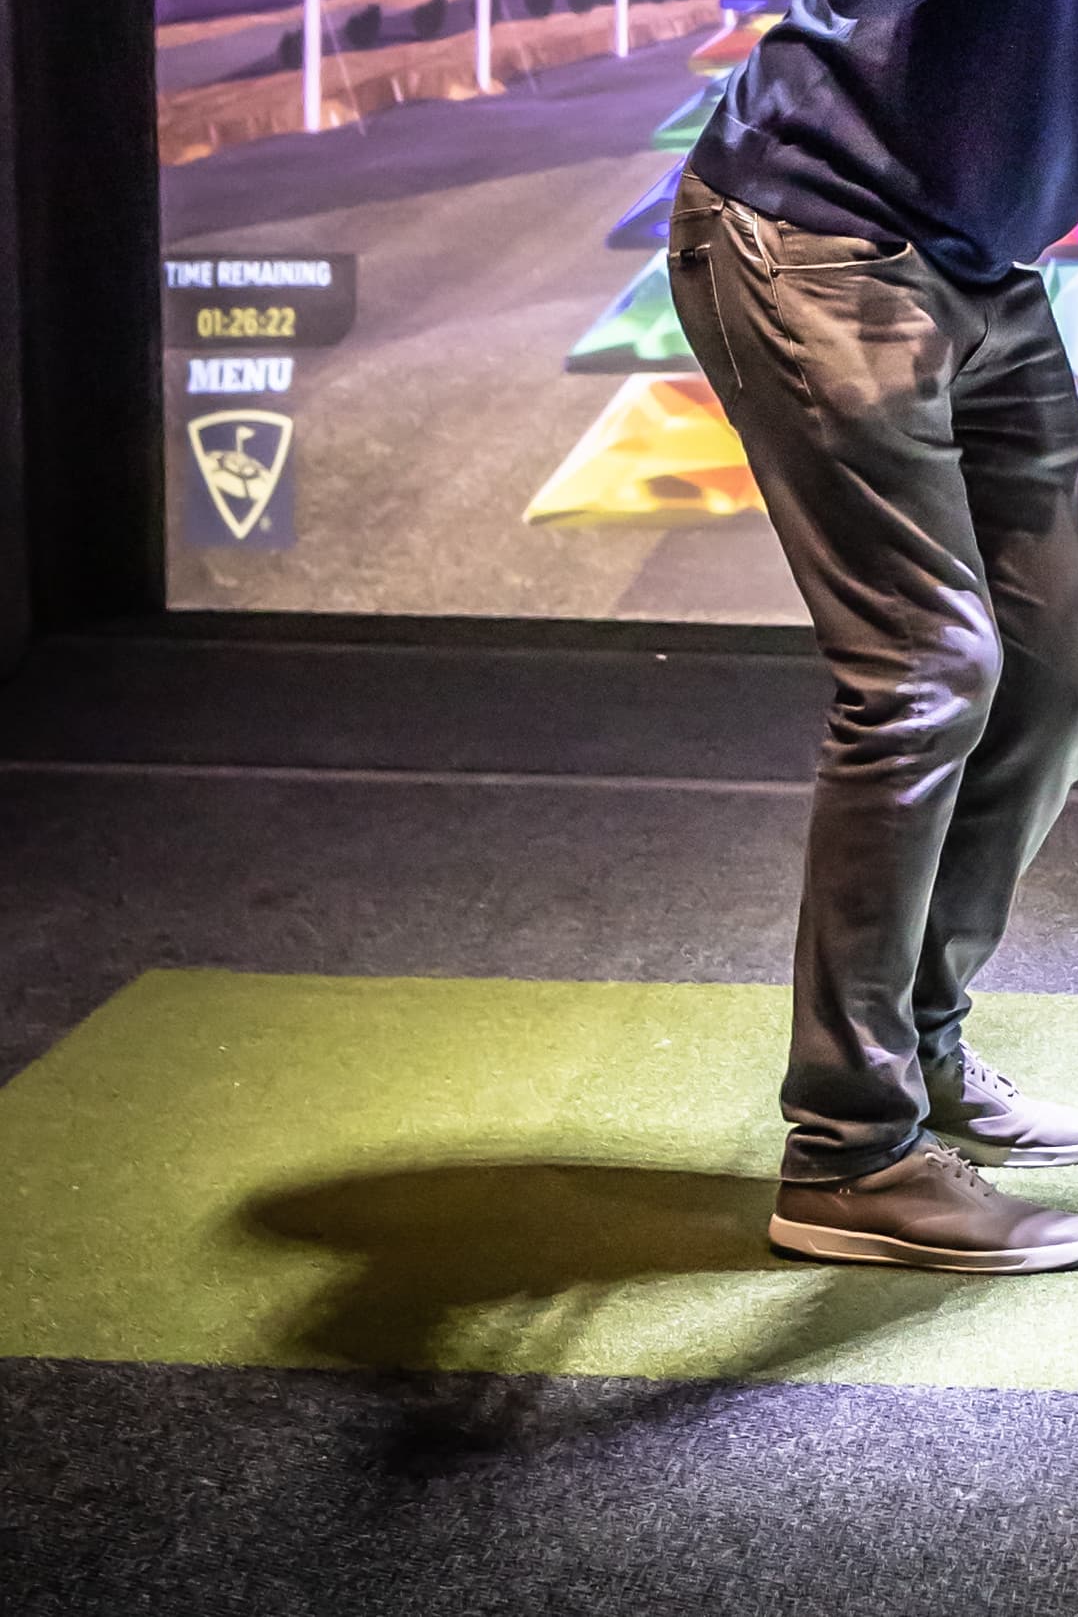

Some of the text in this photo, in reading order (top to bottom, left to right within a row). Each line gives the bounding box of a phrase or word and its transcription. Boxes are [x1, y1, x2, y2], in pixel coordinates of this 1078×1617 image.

[164, 260, 332, 288] TIME REMAINING
[196, 306, 297, 338] 01:26:22
[187, 357, 294, 394] MENU
